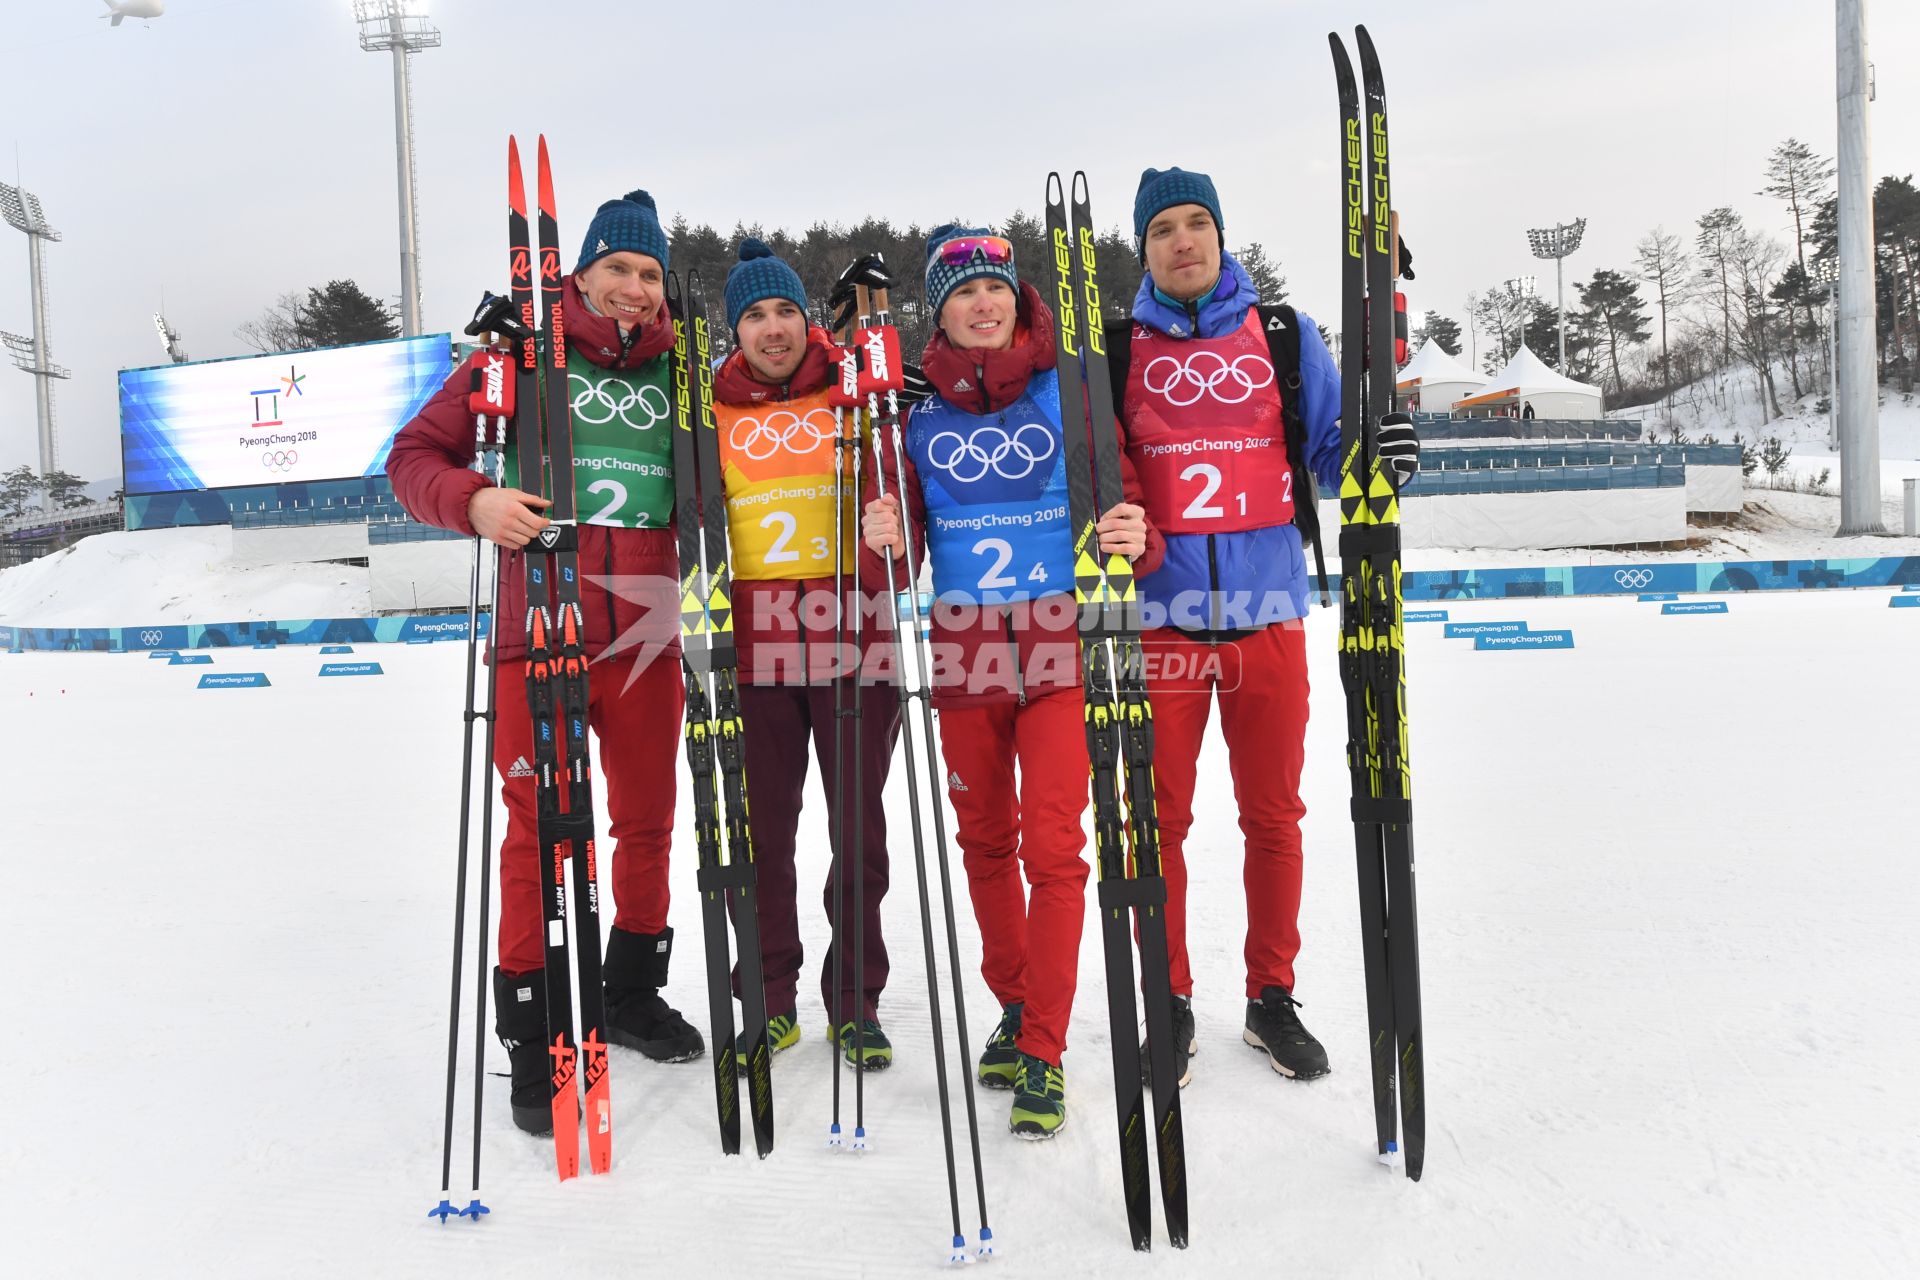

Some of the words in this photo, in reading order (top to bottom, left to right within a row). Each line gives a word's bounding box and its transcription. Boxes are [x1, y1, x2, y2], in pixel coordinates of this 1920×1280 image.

[1347, 118, 1362, 258] FISCHER
[1372, 112, 1388, 254] FISCHER
[1053, 227, 1078, 357] FISCHER
[1079, 226, 1105, 356] FISCHER
[551, 300, 566, 369] ROSSIGNOL
[673, 319, 692, 432] FISCHER
[695, 316, 715, 429] FISCHER
[239, 434, 296, 448] PyeongChang
[297, 431, 317, 441] 2018
[1143, 438, 1243, 457] PyeongChang
[542, 455, 649, 476] PongChang
[650, 464, 672, 478] 2018
[730, 487, 816, 509] PyeongChang
[818, 485, 852, 497] 208
[1179, 463, 1224, 519] 2
[1235, 492, 1247, 516] 1
[1281, 471, 1292, 503] 2
[586, 479, 628, 527] 2
[636, 512, 650, 528] 2
[936, 513, 1032, 531] PyeongChang
[1035, 506, 1066, 523] 2018
[759, 511, 799, 564] 2
[810, 537, 829, 560] 3
[533, 569, 542, 583] C2
[564, 567, 573, 582] C2
[971, 538, 1017, 589] 2
[1028, 561, 1048, 583] 4
[414, 622, 464, 634] PyeongChang
[1453, 625, 1501, 633] PyeongChang
[1485, 635, 1542, 644] PyeongChang
[1543, 634, 1563, 642] 2018
[542, 722, 550, 740] 207
[574, 720, 582, 738] 207
[508, 769, 535, 778] adidas
[554, 843, 563, 884] PREMIUM
[586, 840, 596, 881] PREMIUM
[556, 887, 565, 916] X-IUM
[588, 883, 597, 913] X-IUM
